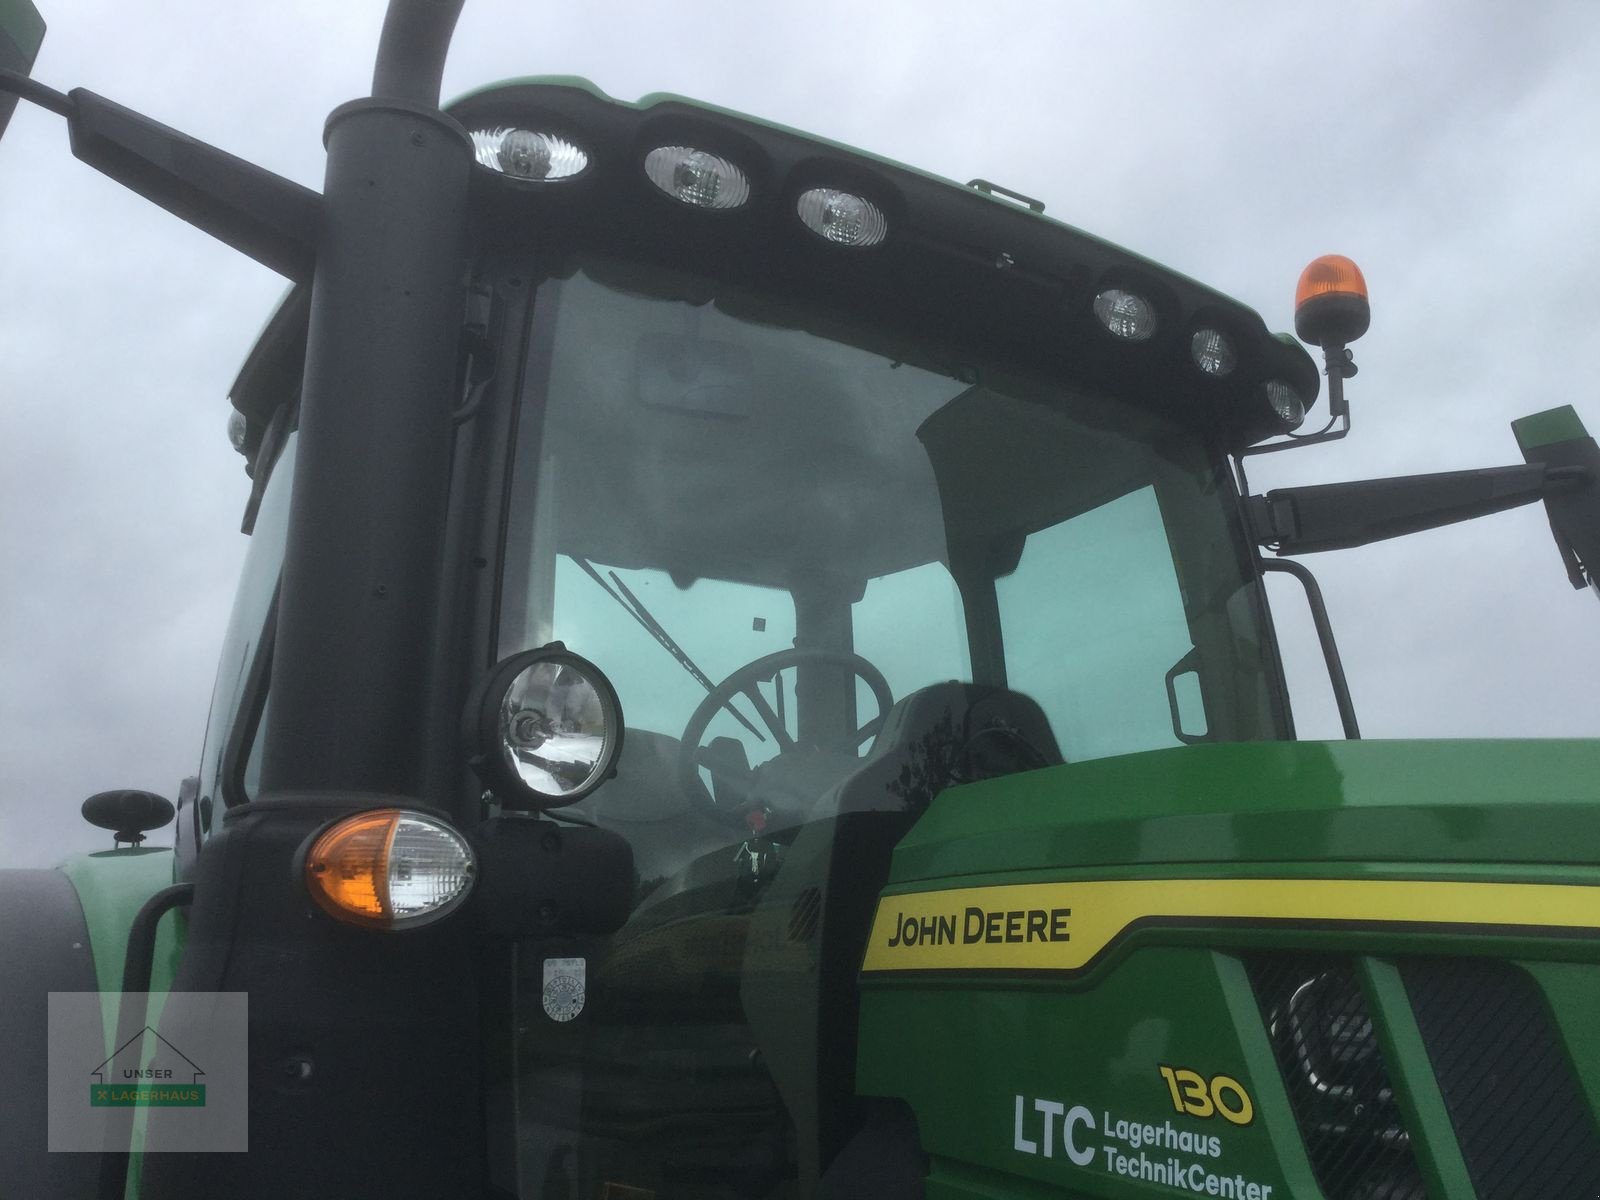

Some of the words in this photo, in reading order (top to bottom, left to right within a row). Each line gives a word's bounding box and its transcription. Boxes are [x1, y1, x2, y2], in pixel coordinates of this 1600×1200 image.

[888, 912, 957, 947] JOHN
[963, 907, 1071, 944] DEERE
[1159, 1065, 1254, 1125] 130
[1014, 1095, 1096, 1166] LTC
[1104, 1111, 1221, 1158] Lagerhaus
[1103, 1146, 1272, 1200] TechnikCenter
